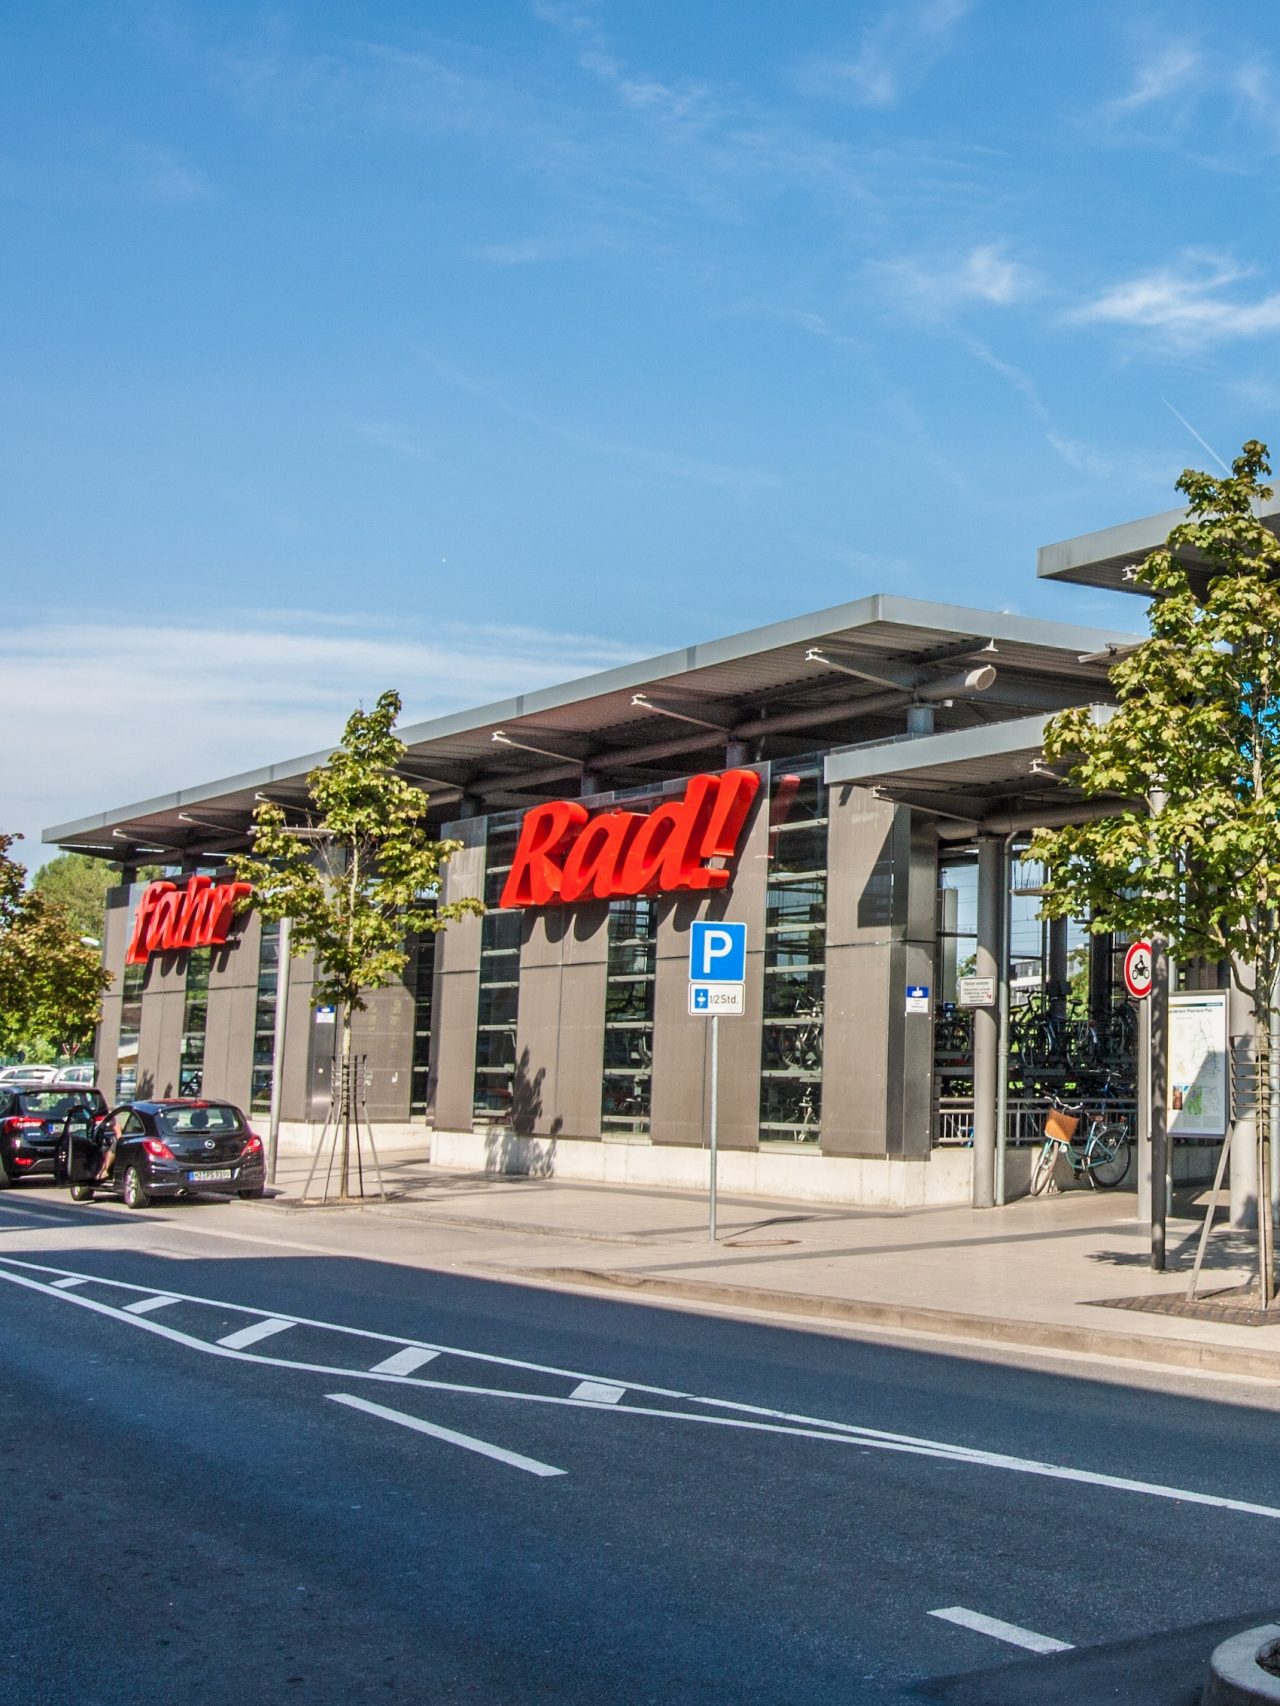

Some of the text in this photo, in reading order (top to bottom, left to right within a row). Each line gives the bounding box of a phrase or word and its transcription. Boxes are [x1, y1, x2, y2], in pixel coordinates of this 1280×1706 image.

[499, 769, 760, 909] Rad!
[126, 875, 254, 965] fahr
[703, 930, 733, 973] P
